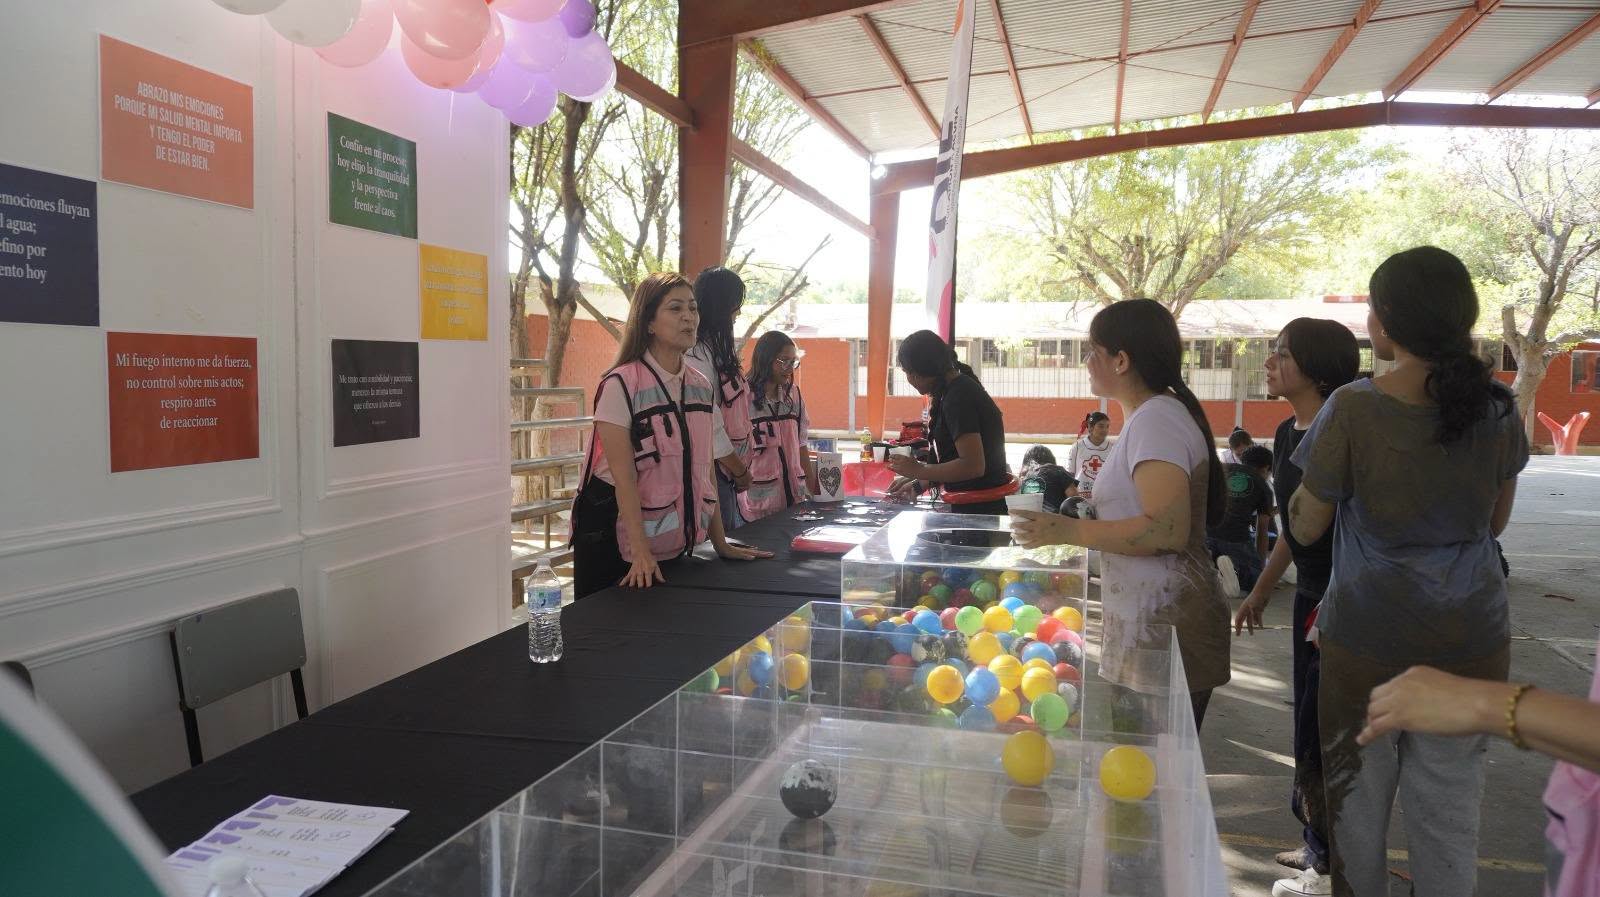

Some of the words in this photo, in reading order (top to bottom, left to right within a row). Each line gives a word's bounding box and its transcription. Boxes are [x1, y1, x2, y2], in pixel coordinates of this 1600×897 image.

[138, 82, 168, 103] ABRAZO
[170, 91, 184, 108] MIS
[185, 96, 224, 120] EMOCIONES
[114, 94, 147, 117] PORQUE
[148, 104, 158, 120] MI
[160, 107, 184, 127] SALUD
[185, 116, 213, 136] MENTAL
[213, 124, 242, 144] IMPORTA
[149, 124, 156, 138] Y
[156, 126, 181, 145] TENGO
[182, 132, 192, 148] EL
[192, 135, 216, 154] PODER
[156, 145, 166, 161] DE
[167, 147, 191, 166] ESTAR
[364, 146, 372, 156] en
[337, 153, 351, 172] hoy
[351, 158, 366, 175] elijo
[366, 161, 373, 175] la
[374, 167, 410, 187] tranquilidad
[356, 178, 363, 191] la
[364, 184, 399, 200] perspectiva
[0, 193, 56, 212] mociones
[57, 198, 91, 220] fluyan
[354, 197, 374, 213] frente
[374, 203, 380, 214] al
[6, 218, 37, 236] agua;
[26, 244, 47, 260] por
[26, 263, 47, 284] hoy
[116, 353, 130, 367] Mi
[132, 353, 160, 371] fuego
[162, 354, 198, 368] interno
[198, 358, 211, 368] me
[212, 354, 222, 368] da
[126, 379, 140, 389] no
[142, 376, 176, 389] control
[179, 376, 202, 388] sobre
[203, 376, 219, 388] mis
[220, 378, 244, 389] actos;
[160, 396, 192, 412] respiro
[194, 397, 216, 408] antes
[160, 416, 172, 429] de
[173, 414, 218, 428] reaccionar
